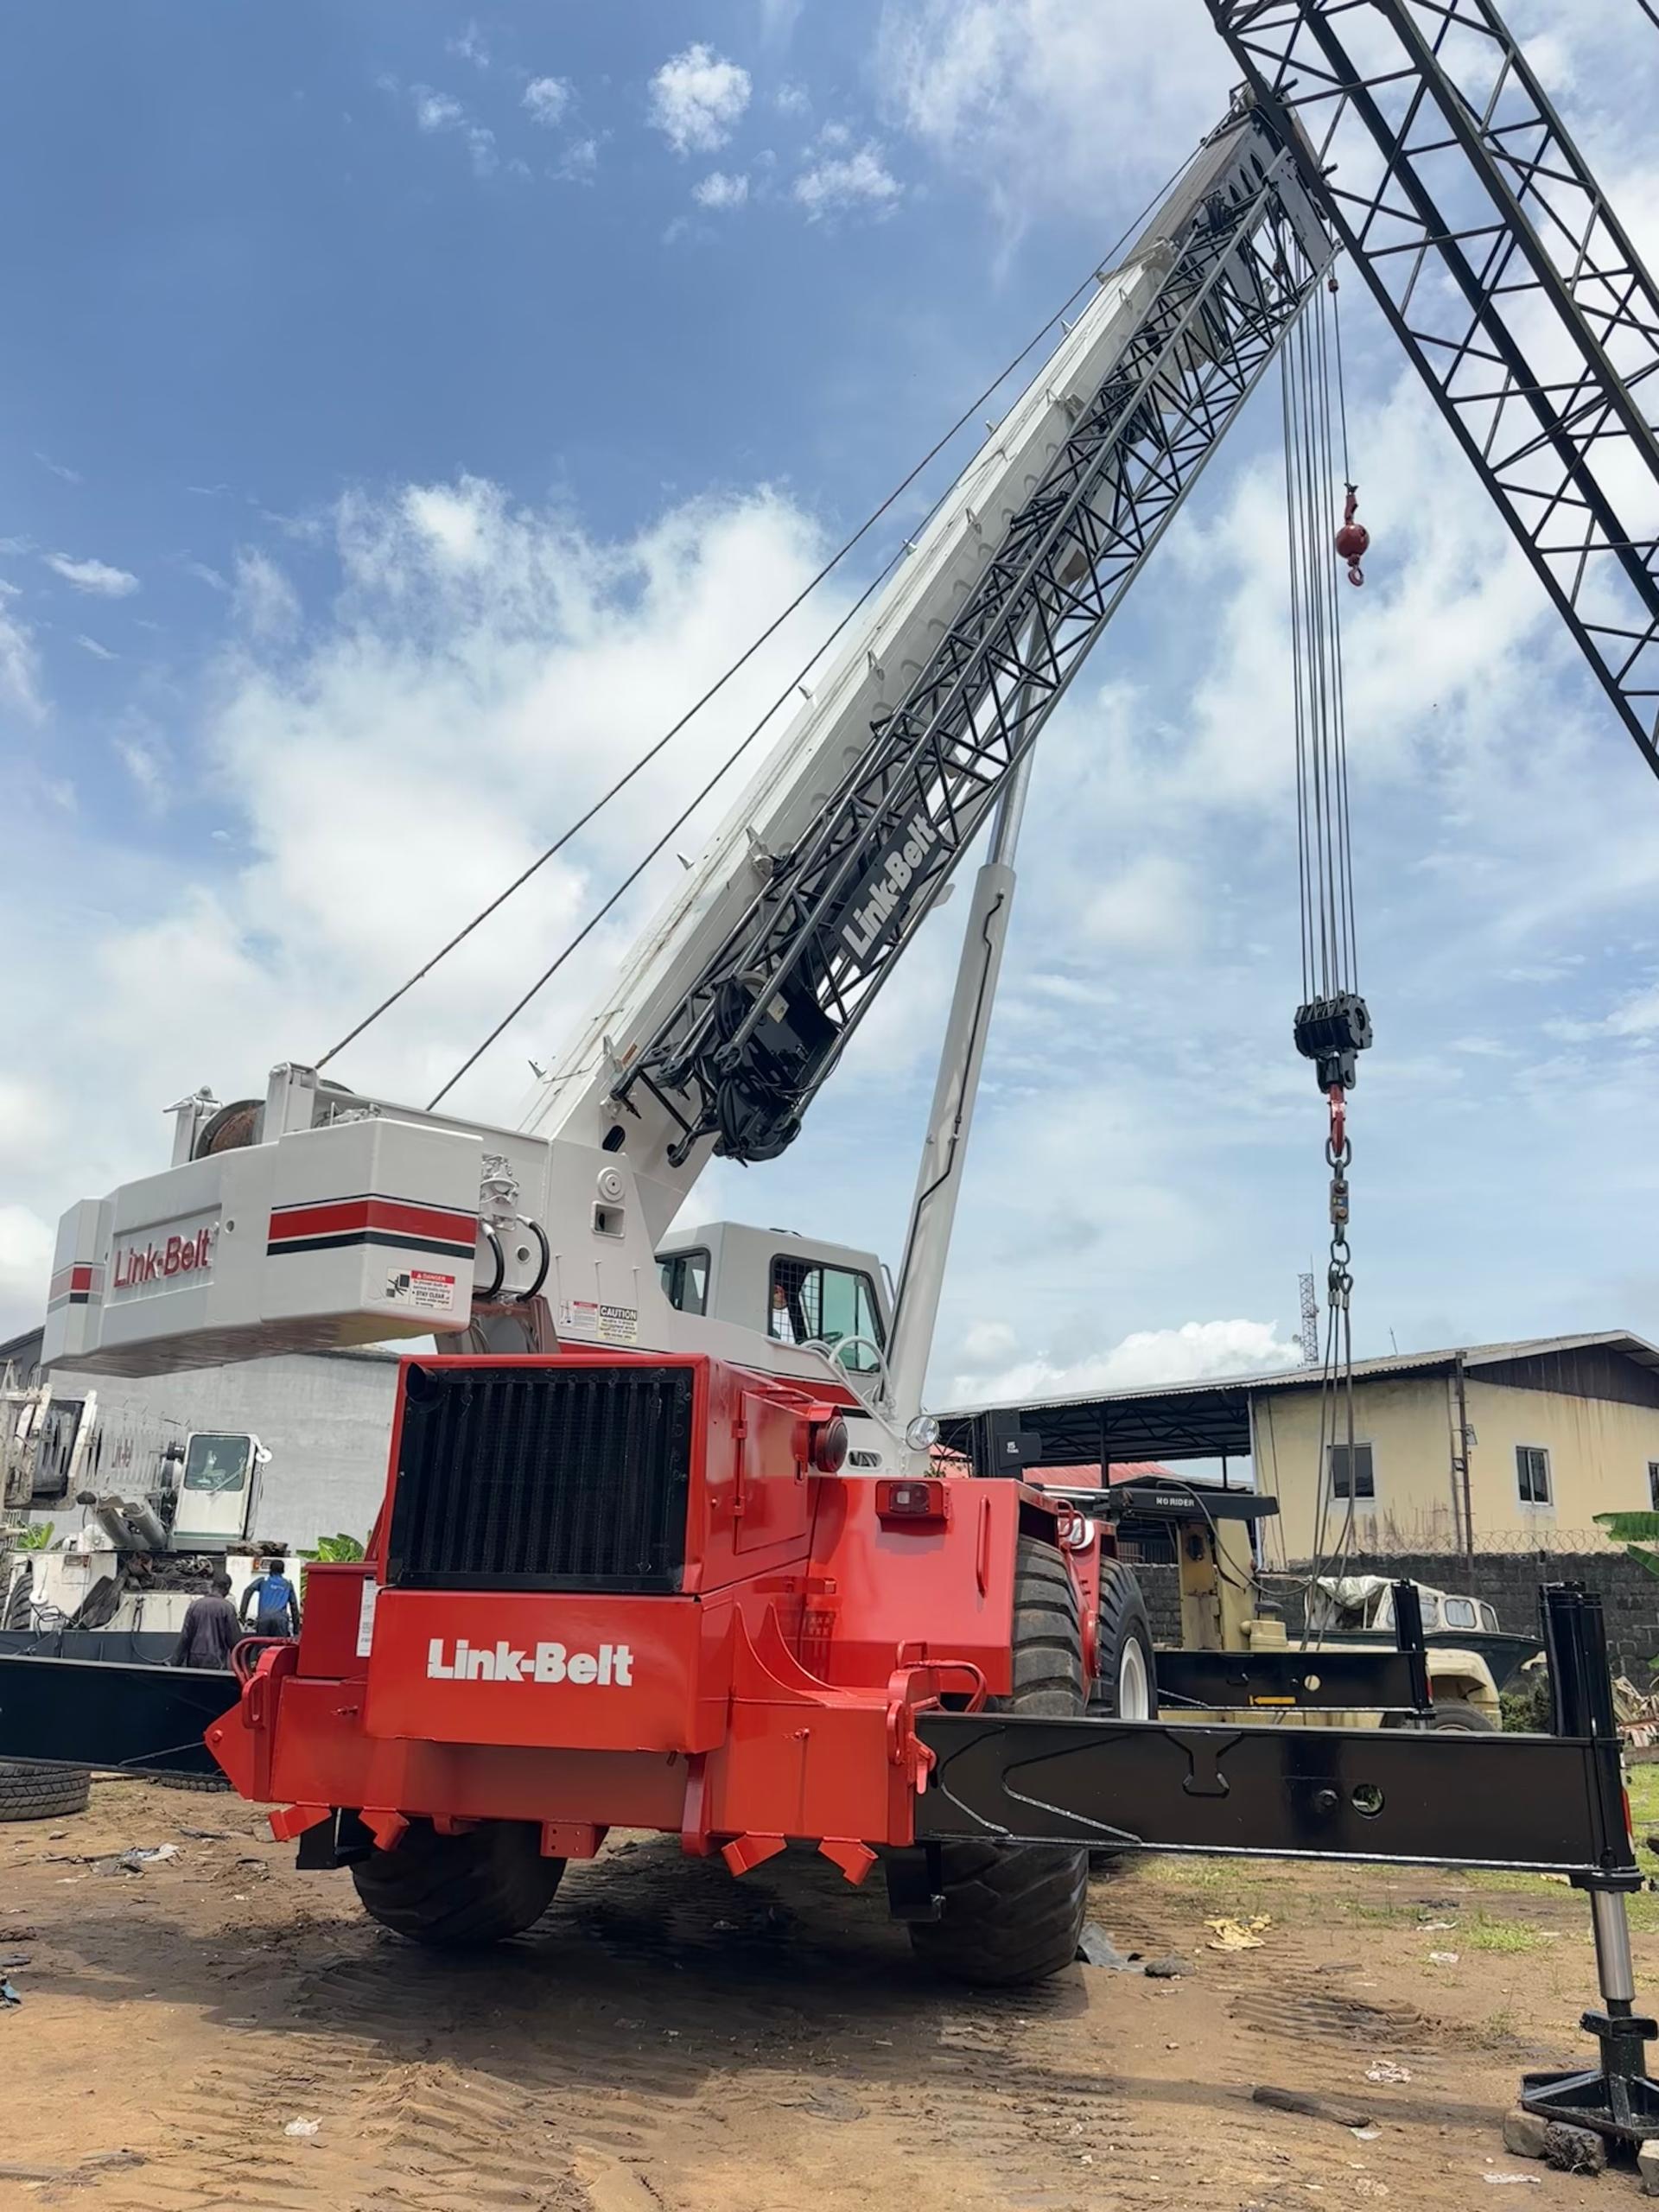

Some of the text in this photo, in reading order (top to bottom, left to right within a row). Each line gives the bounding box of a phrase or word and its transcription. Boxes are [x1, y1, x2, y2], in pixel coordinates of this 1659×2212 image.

[842, 812, 938, 959] Link-Belt
[113, 1228, 212, 1287] Link-Belt
[601, 1306, 636, 1319] CAUTION
[427, 1638, 633, 1687] Link-Belt
